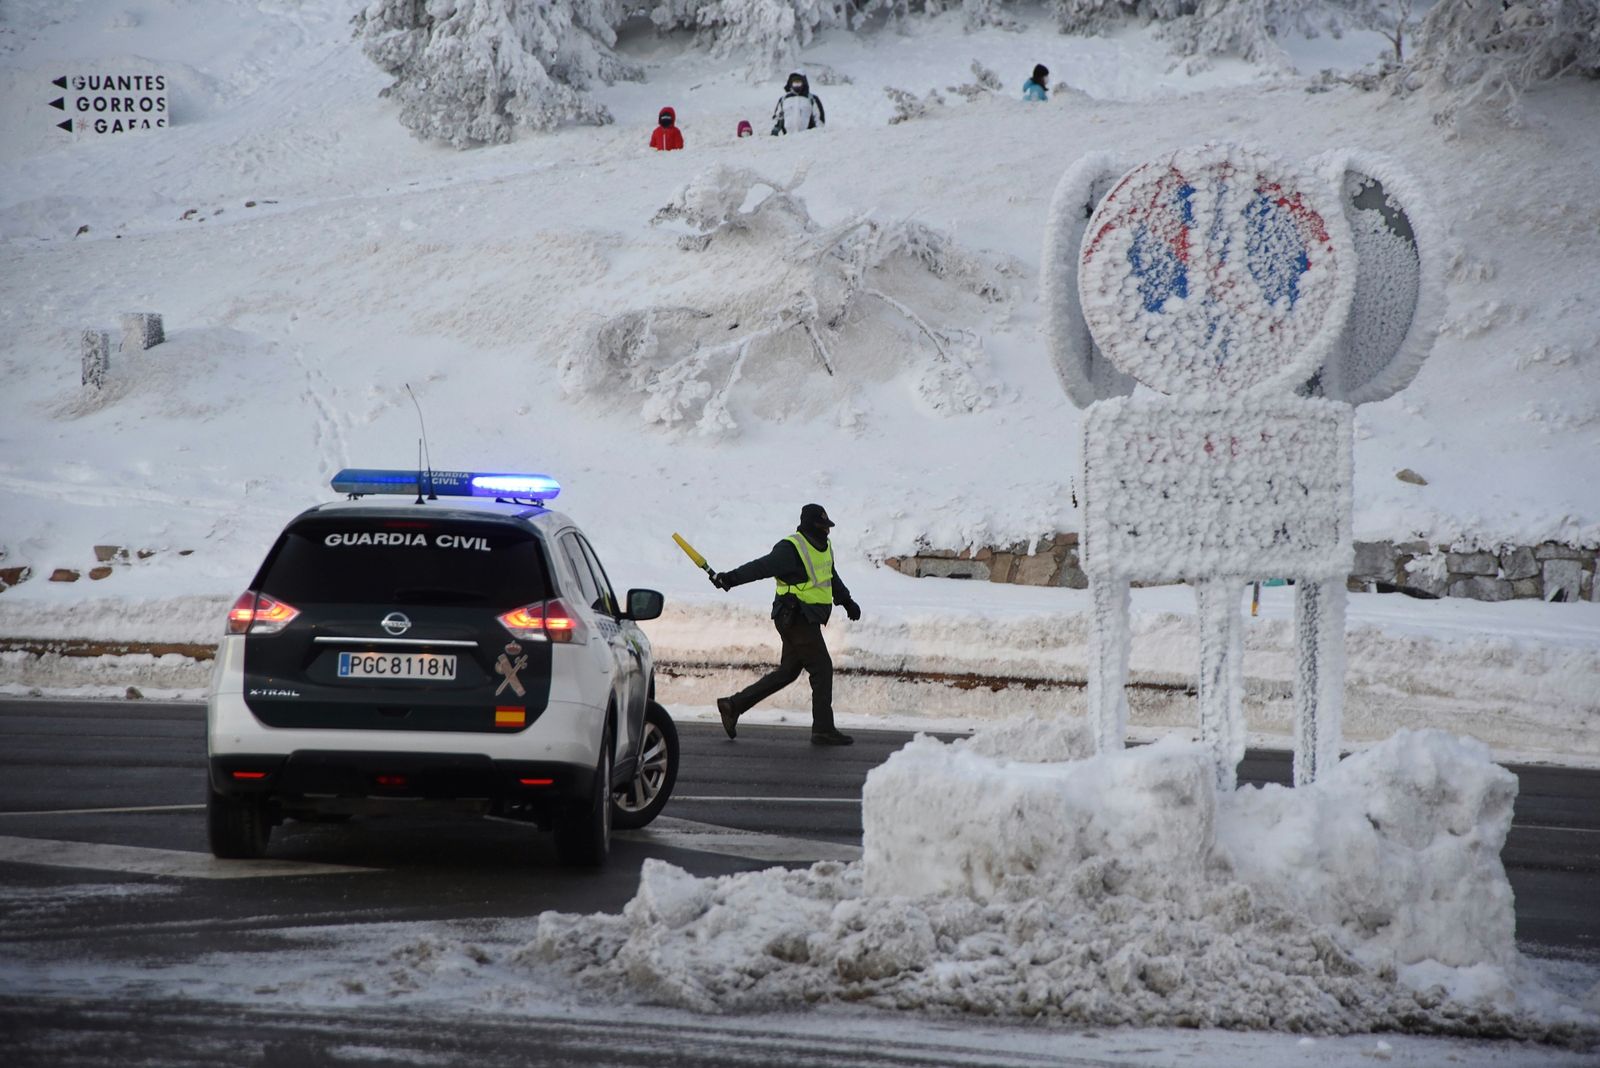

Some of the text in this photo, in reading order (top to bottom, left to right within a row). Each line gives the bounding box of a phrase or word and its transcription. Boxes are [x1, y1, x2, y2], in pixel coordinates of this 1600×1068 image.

[72, 75, 165, 91] GUANTES
[76, 96, 166, 112] GORROS
[423, 471, 469, 479] GUARDIA
[431, 477, 460, 485] CIVIL
[324, 532, 492, 552] GUARDIA CIVIL
[249, 688, 300, 697] X-TRAIL
